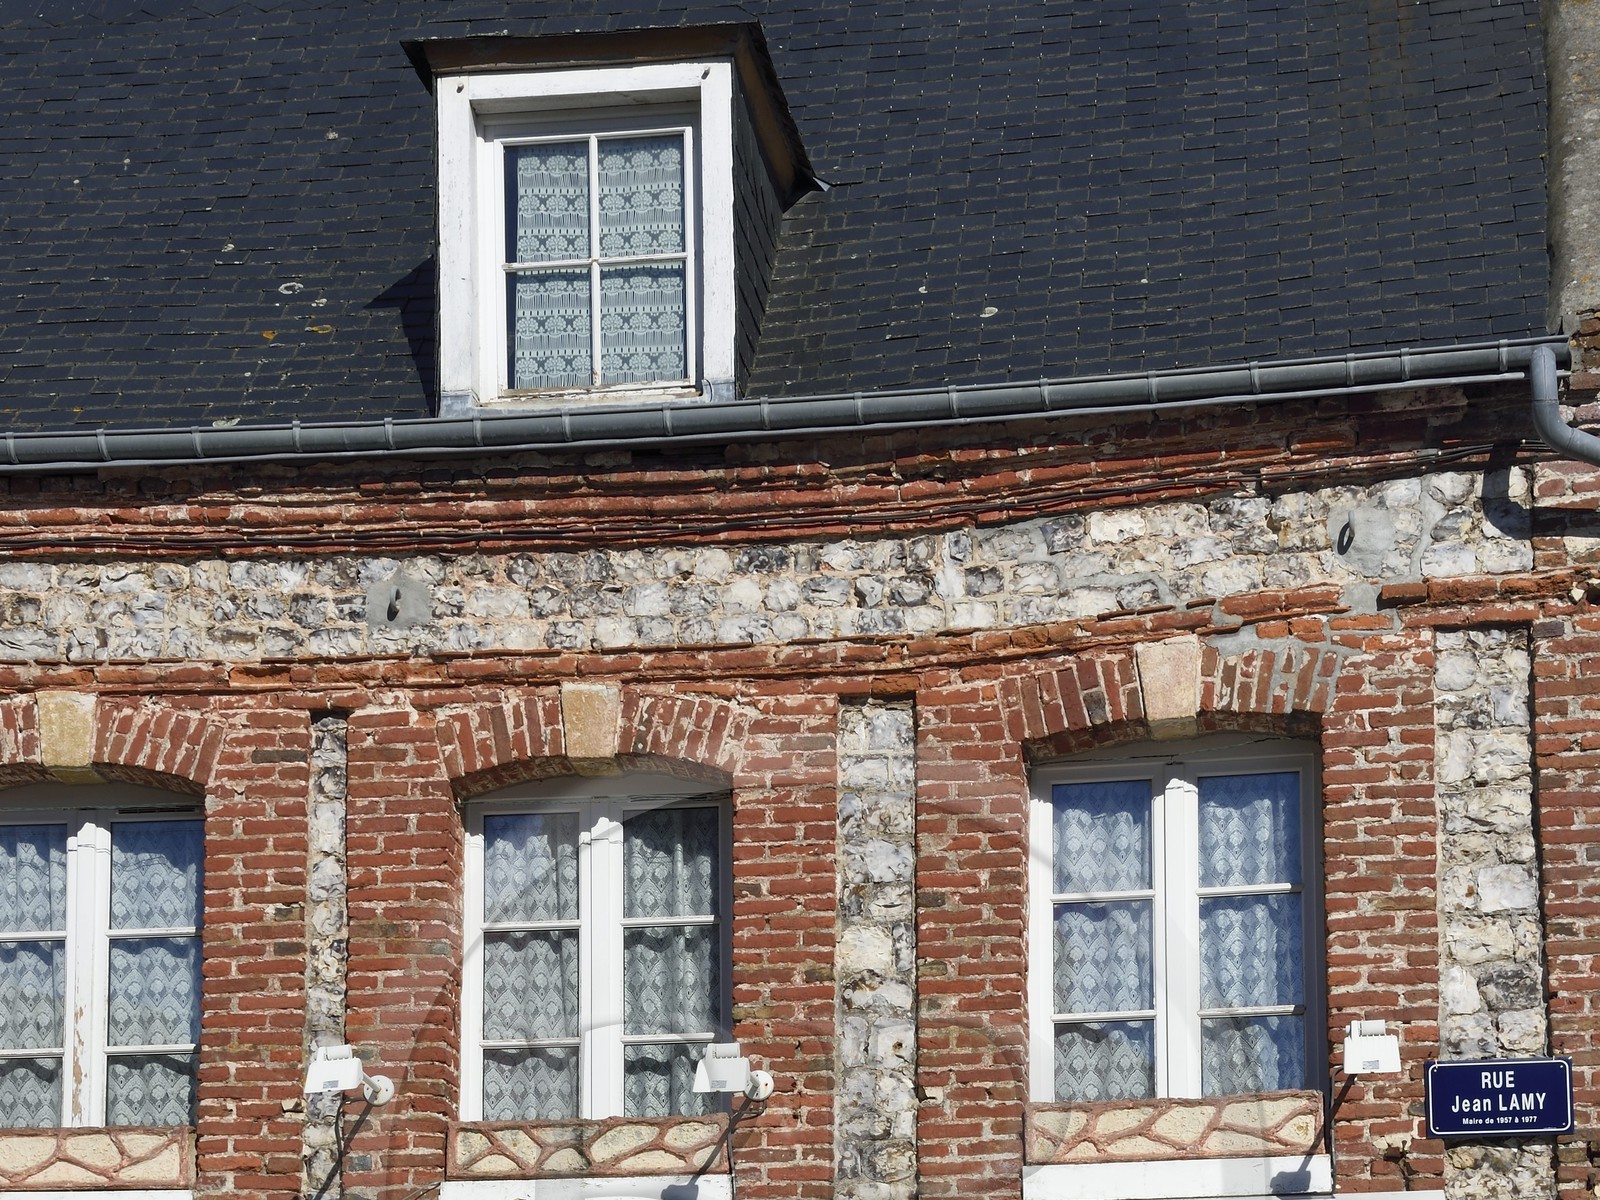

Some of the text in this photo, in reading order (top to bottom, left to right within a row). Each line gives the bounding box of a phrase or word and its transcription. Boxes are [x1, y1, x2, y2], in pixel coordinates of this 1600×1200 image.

[1481, 1071, 1515, 1089] RUE
[1451, 1092, 1546, 1113] Jean LAMY
[1462, 1117, 1483, 1125] Maire
[1521, 1115, 1537, 1123] 1977
